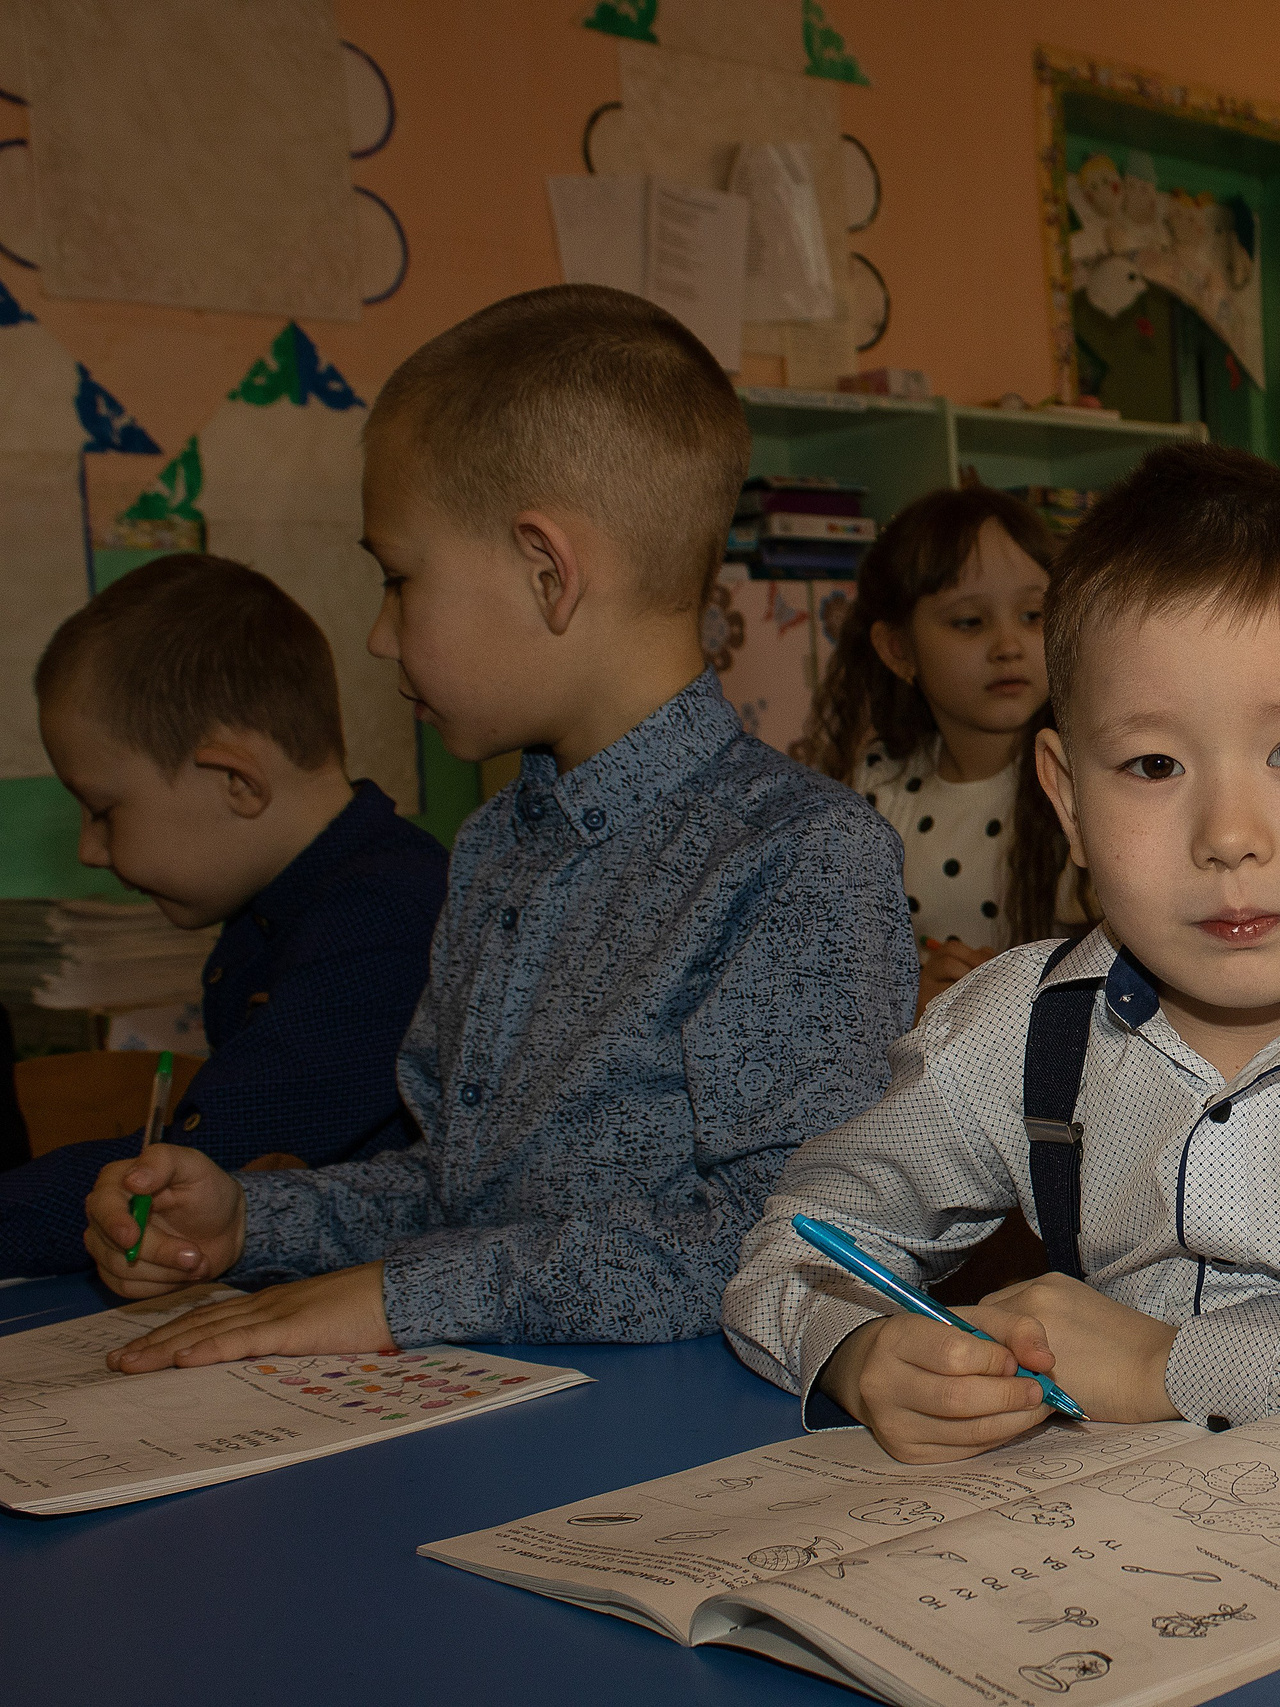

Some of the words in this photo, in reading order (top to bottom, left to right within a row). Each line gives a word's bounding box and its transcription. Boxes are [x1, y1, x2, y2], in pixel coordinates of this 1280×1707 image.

[1098, 1538, 1124, 1551] ТУ
[1071, 1545, 1096, 1561] СА
[1042, 1555, 1069, 1571] ВА
[1010, 1567, 1041, 1581] ЛО
[981, 1576, 1010, 1592] РО
[949, 1586, 979, 1601] КУ
[918, 1594, 948, 1611] НО
